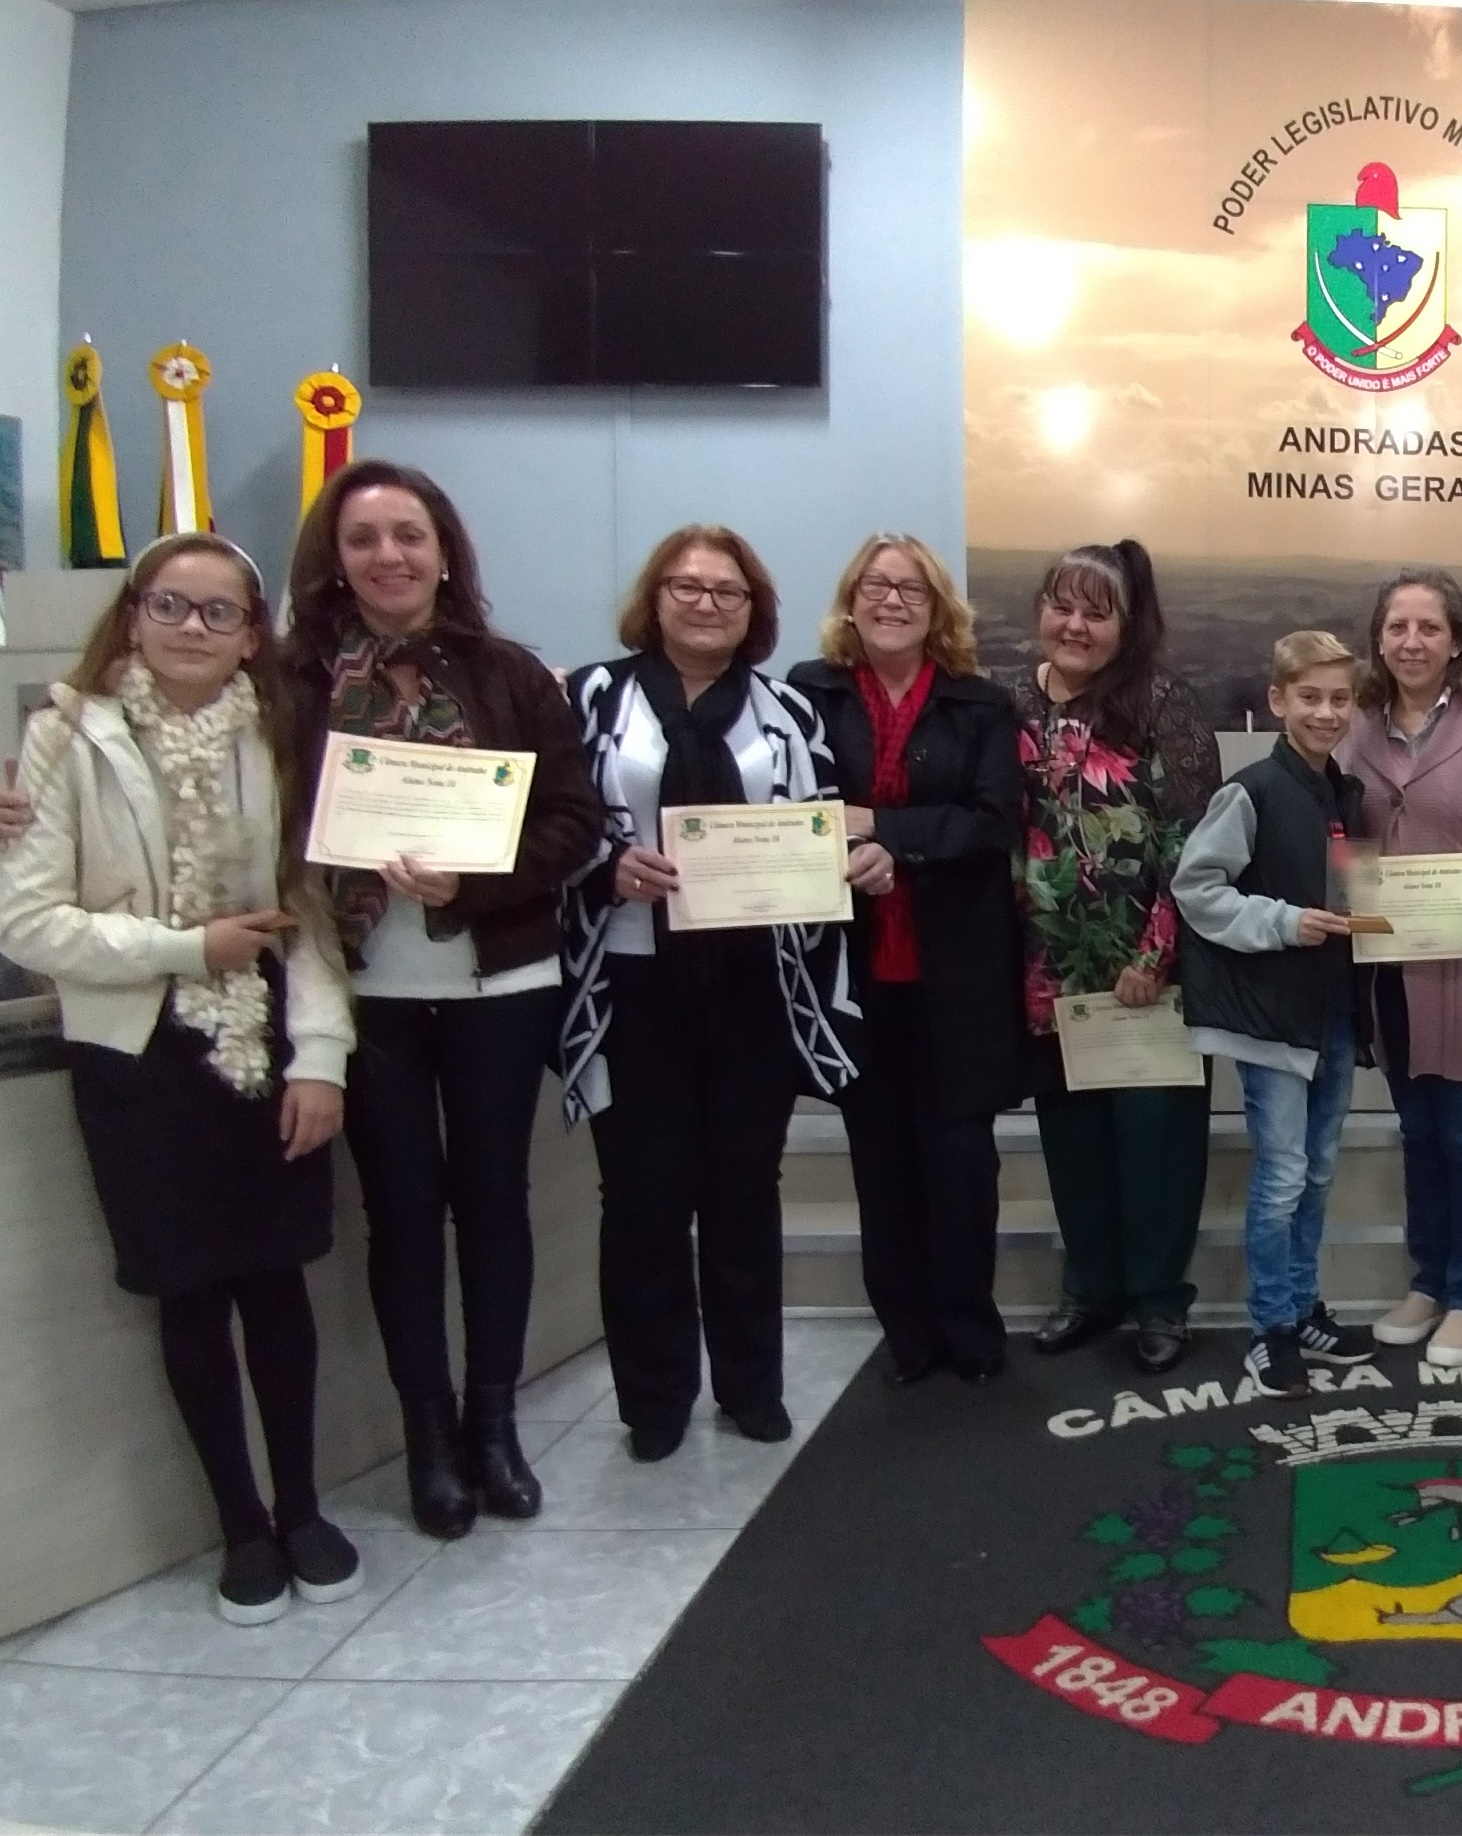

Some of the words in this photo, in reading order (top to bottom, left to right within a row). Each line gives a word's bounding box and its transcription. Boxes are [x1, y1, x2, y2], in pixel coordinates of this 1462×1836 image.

[1212, 148, 1279, 236] PODER
[1270, 95, 1440, 156] LEGISLATIVO
[1307, 346, 1317, 356] O
[1314, 353, 1348, 382] PODER
[1348, 375, 1381, 390] UNIDO
[1391, 373, 1416, 388] MAIS
[1416, 349, 1448, 378] FORTE
[1247, 471, 1355, 500] MINAS
[1030, 1643, 1181, 1722] 1848
